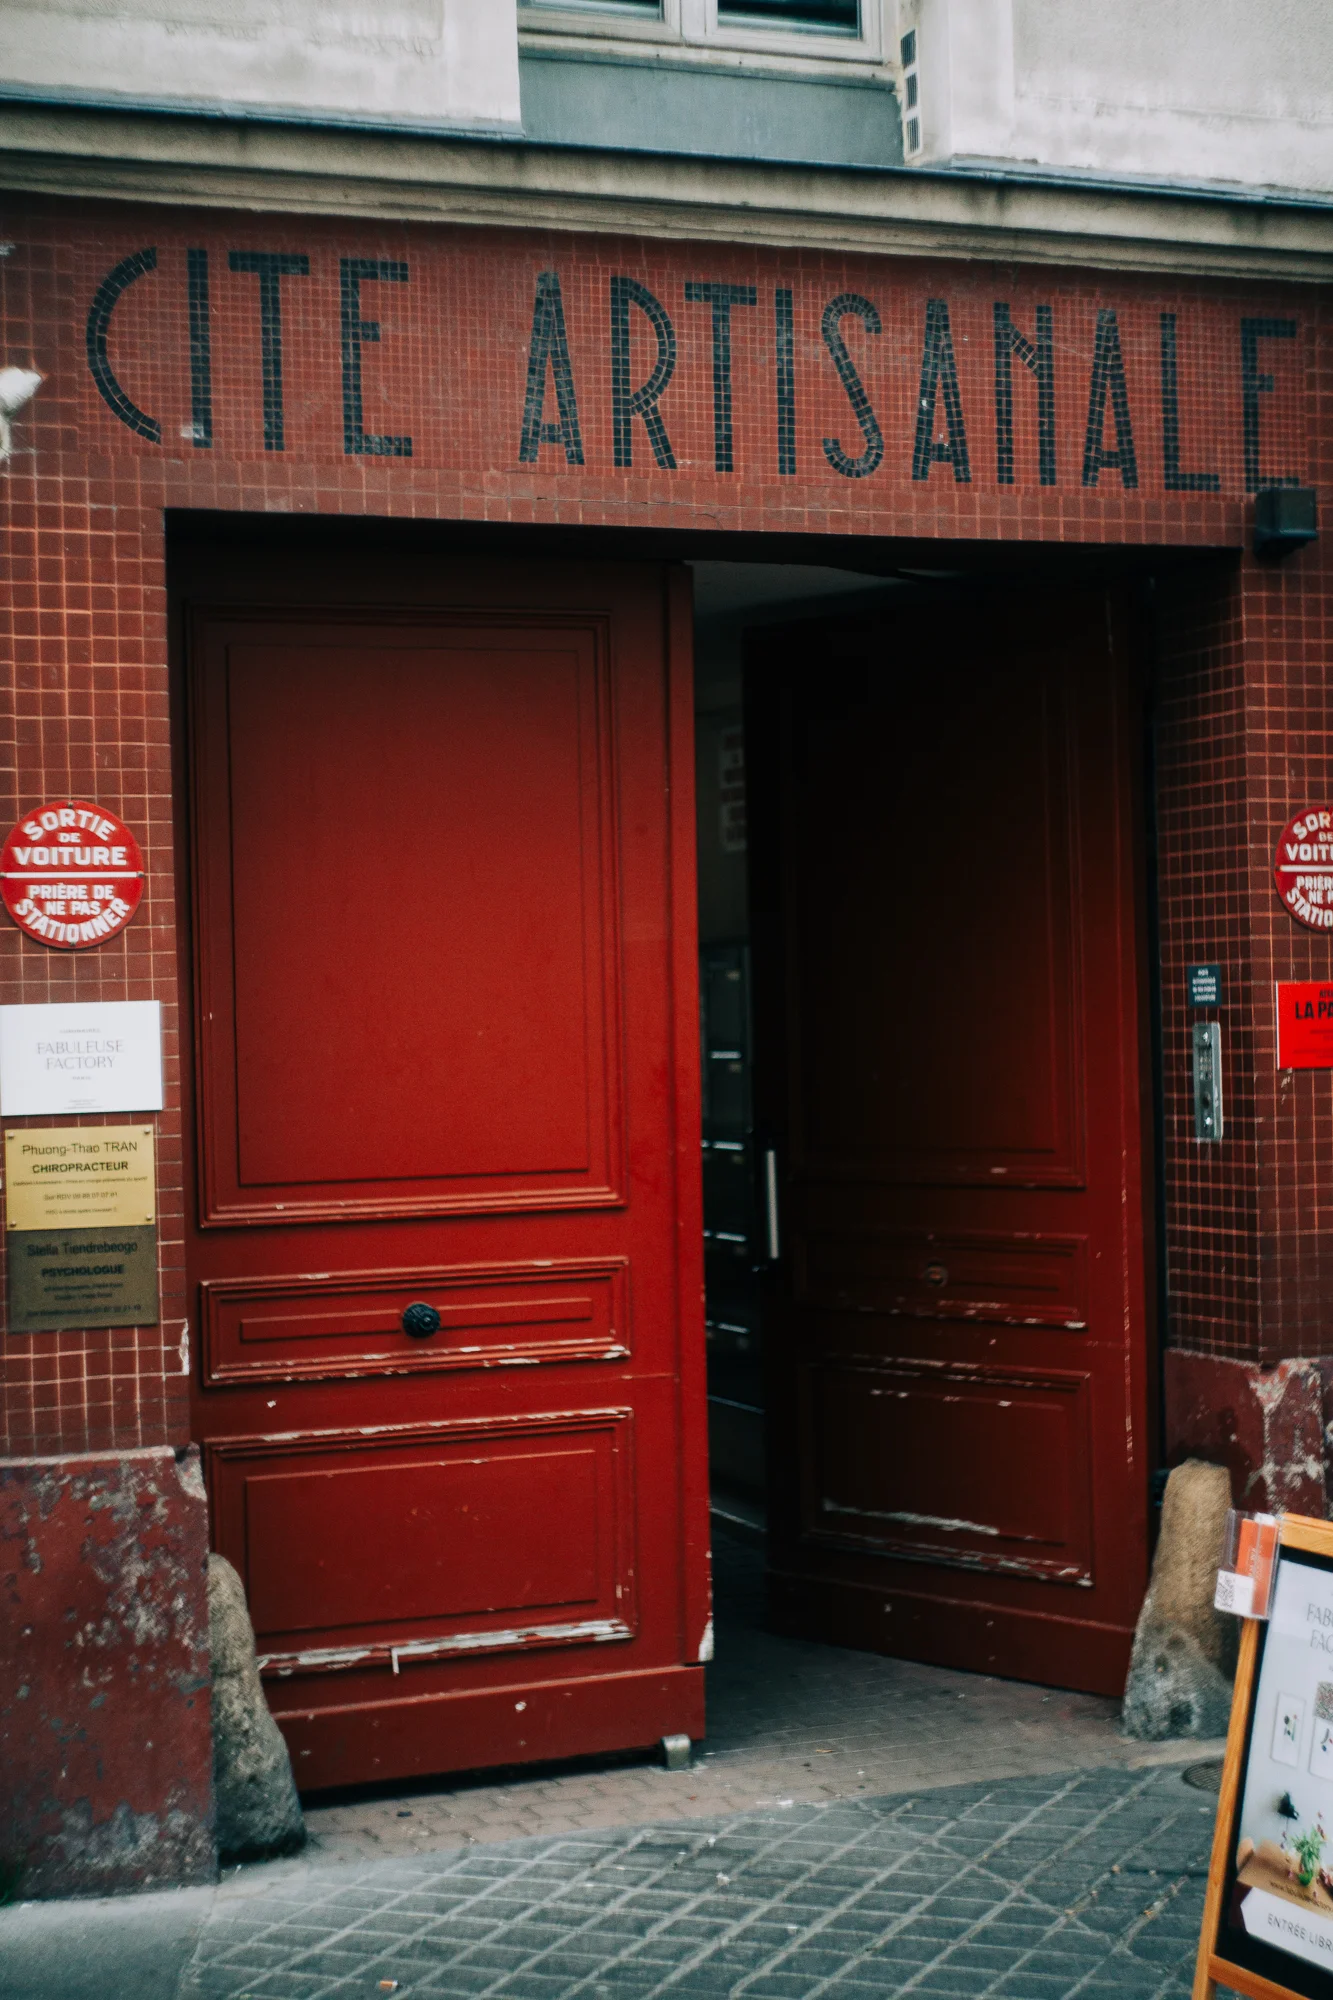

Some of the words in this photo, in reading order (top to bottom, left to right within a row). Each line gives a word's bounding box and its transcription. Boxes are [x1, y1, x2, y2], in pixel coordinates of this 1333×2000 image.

[86, 246, 413, 458] CITE
[518, 269, 1300, 493] ARTISANALE
[23, 808, 116, 841] SORTIE
[1293, 811, 1333, 840] SOR
[58, 832, 81, 843] DE
[12, 846, 127, 866] VOITURE
[28, 882, 88, 899] PRIÈRE
[93, 884, 115, 899] DE
[1296, 873, 1333, 891] PRIÈR
[1308, 889, 1323, 905] NE
[44, 901, 66, 916] NE
[71, 901, 101, 916] PAS
[15, 898, 131, 943] STATIONNER
[1295, 1001, 1314, 1019] LA
[37, 1039, 124, 1055] FABULEUSE
[46, 1056, 116, 1070] FACTORY
[104, 1141, 138, 1153] TRAN
[32, 1161, 129, 1174] CHIROPRACTEUR
[41, 1264, 125, 1277] PSYCHOLOGUE
[1307, 1603, 1333, 1627] FAB
[1267, 1913, 1307, 1940] ENTRÉE
